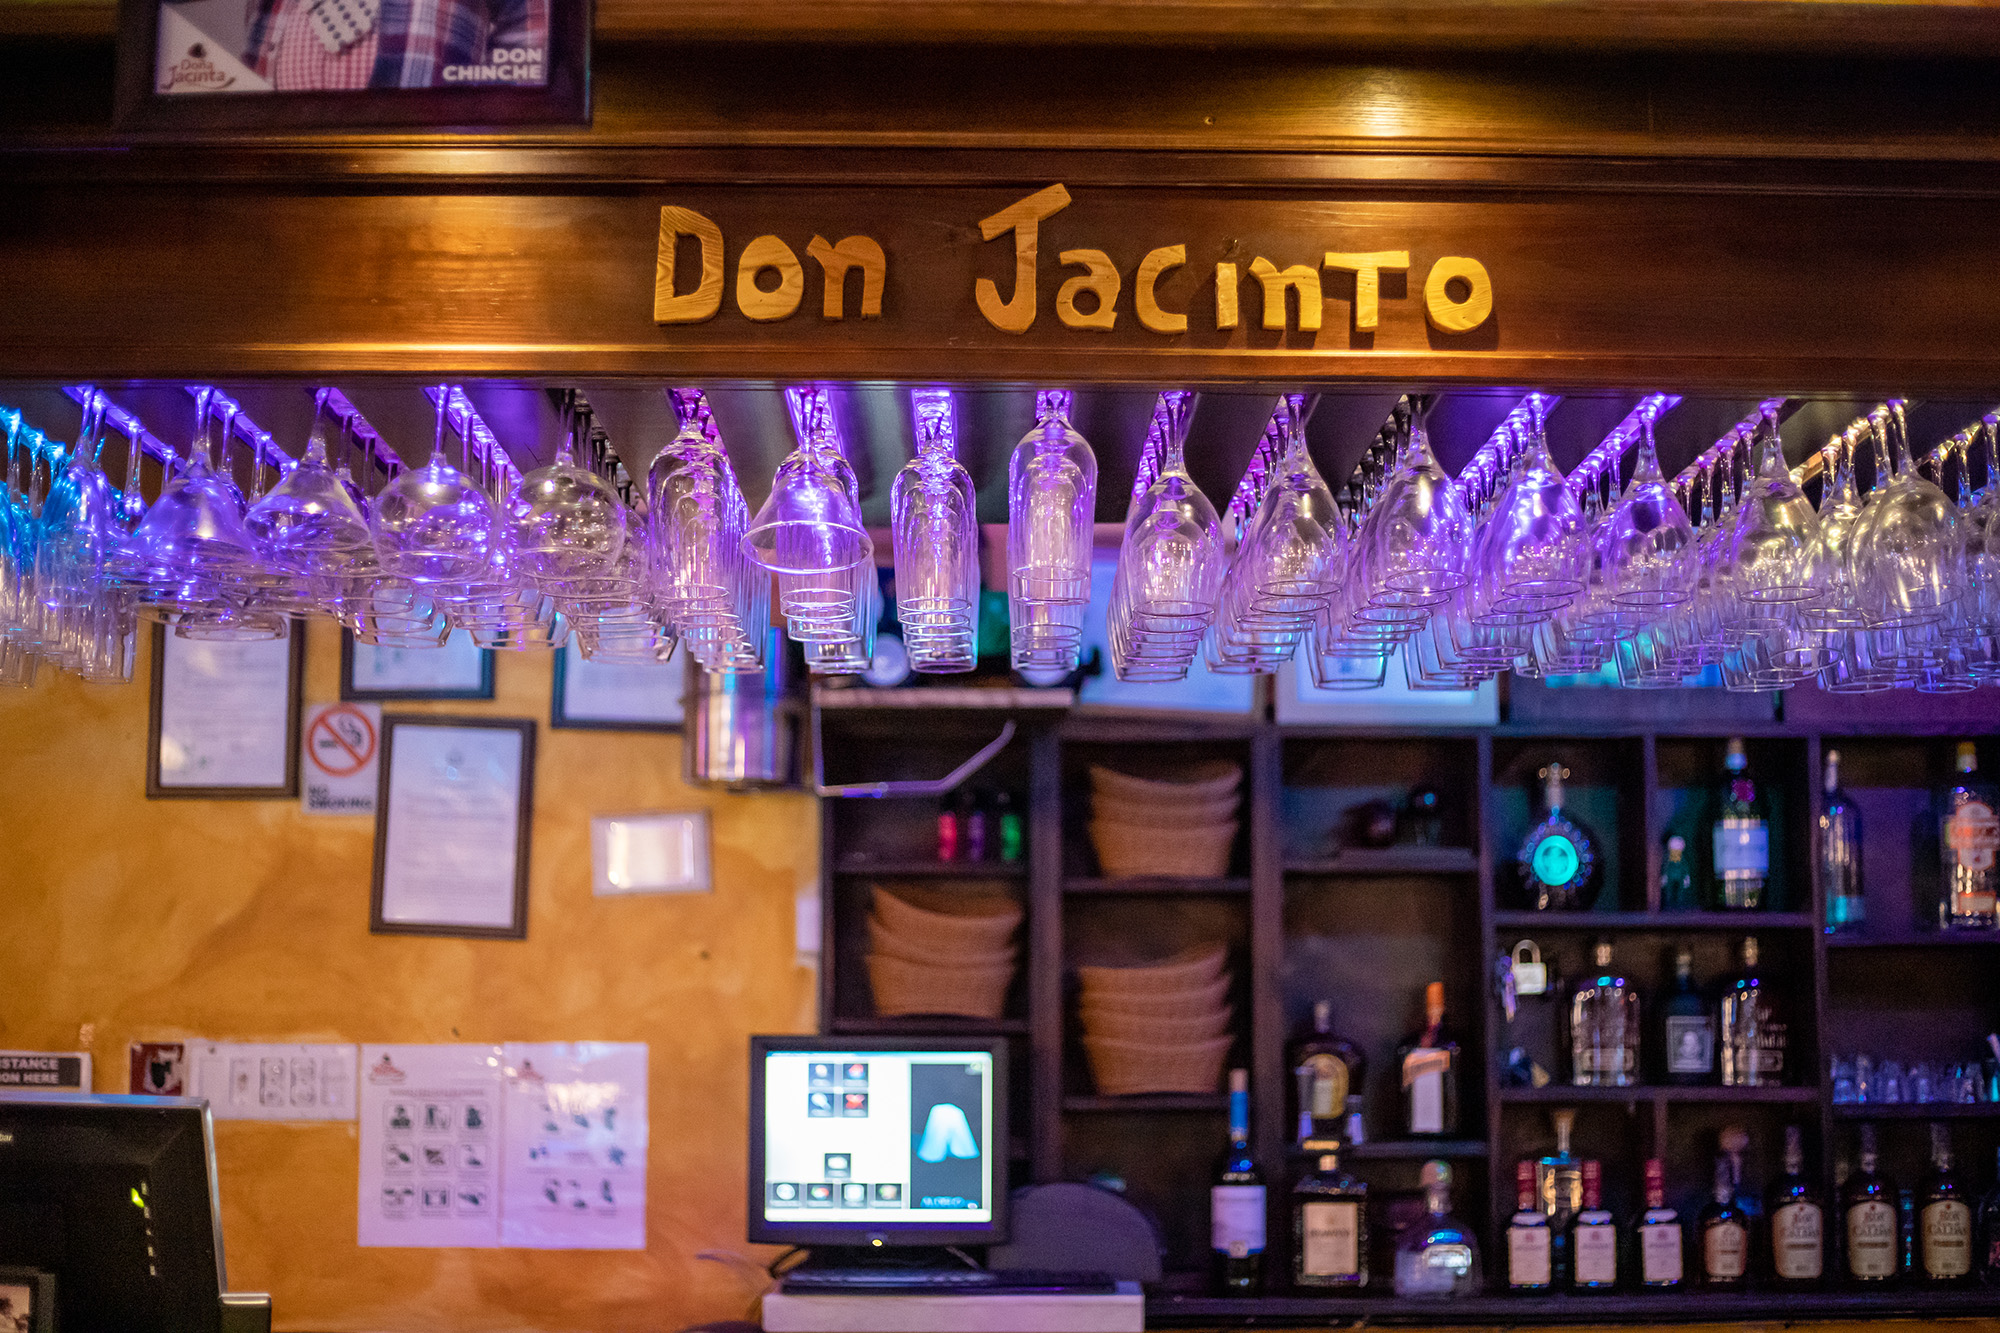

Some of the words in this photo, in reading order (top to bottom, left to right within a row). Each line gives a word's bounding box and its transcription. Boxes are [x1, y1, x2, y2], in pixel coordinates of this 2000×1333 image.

[492, 48, 543, 63] DON
[442, 64, 542, 81] CHINCHE
[654, 205, 887, 325] Don
